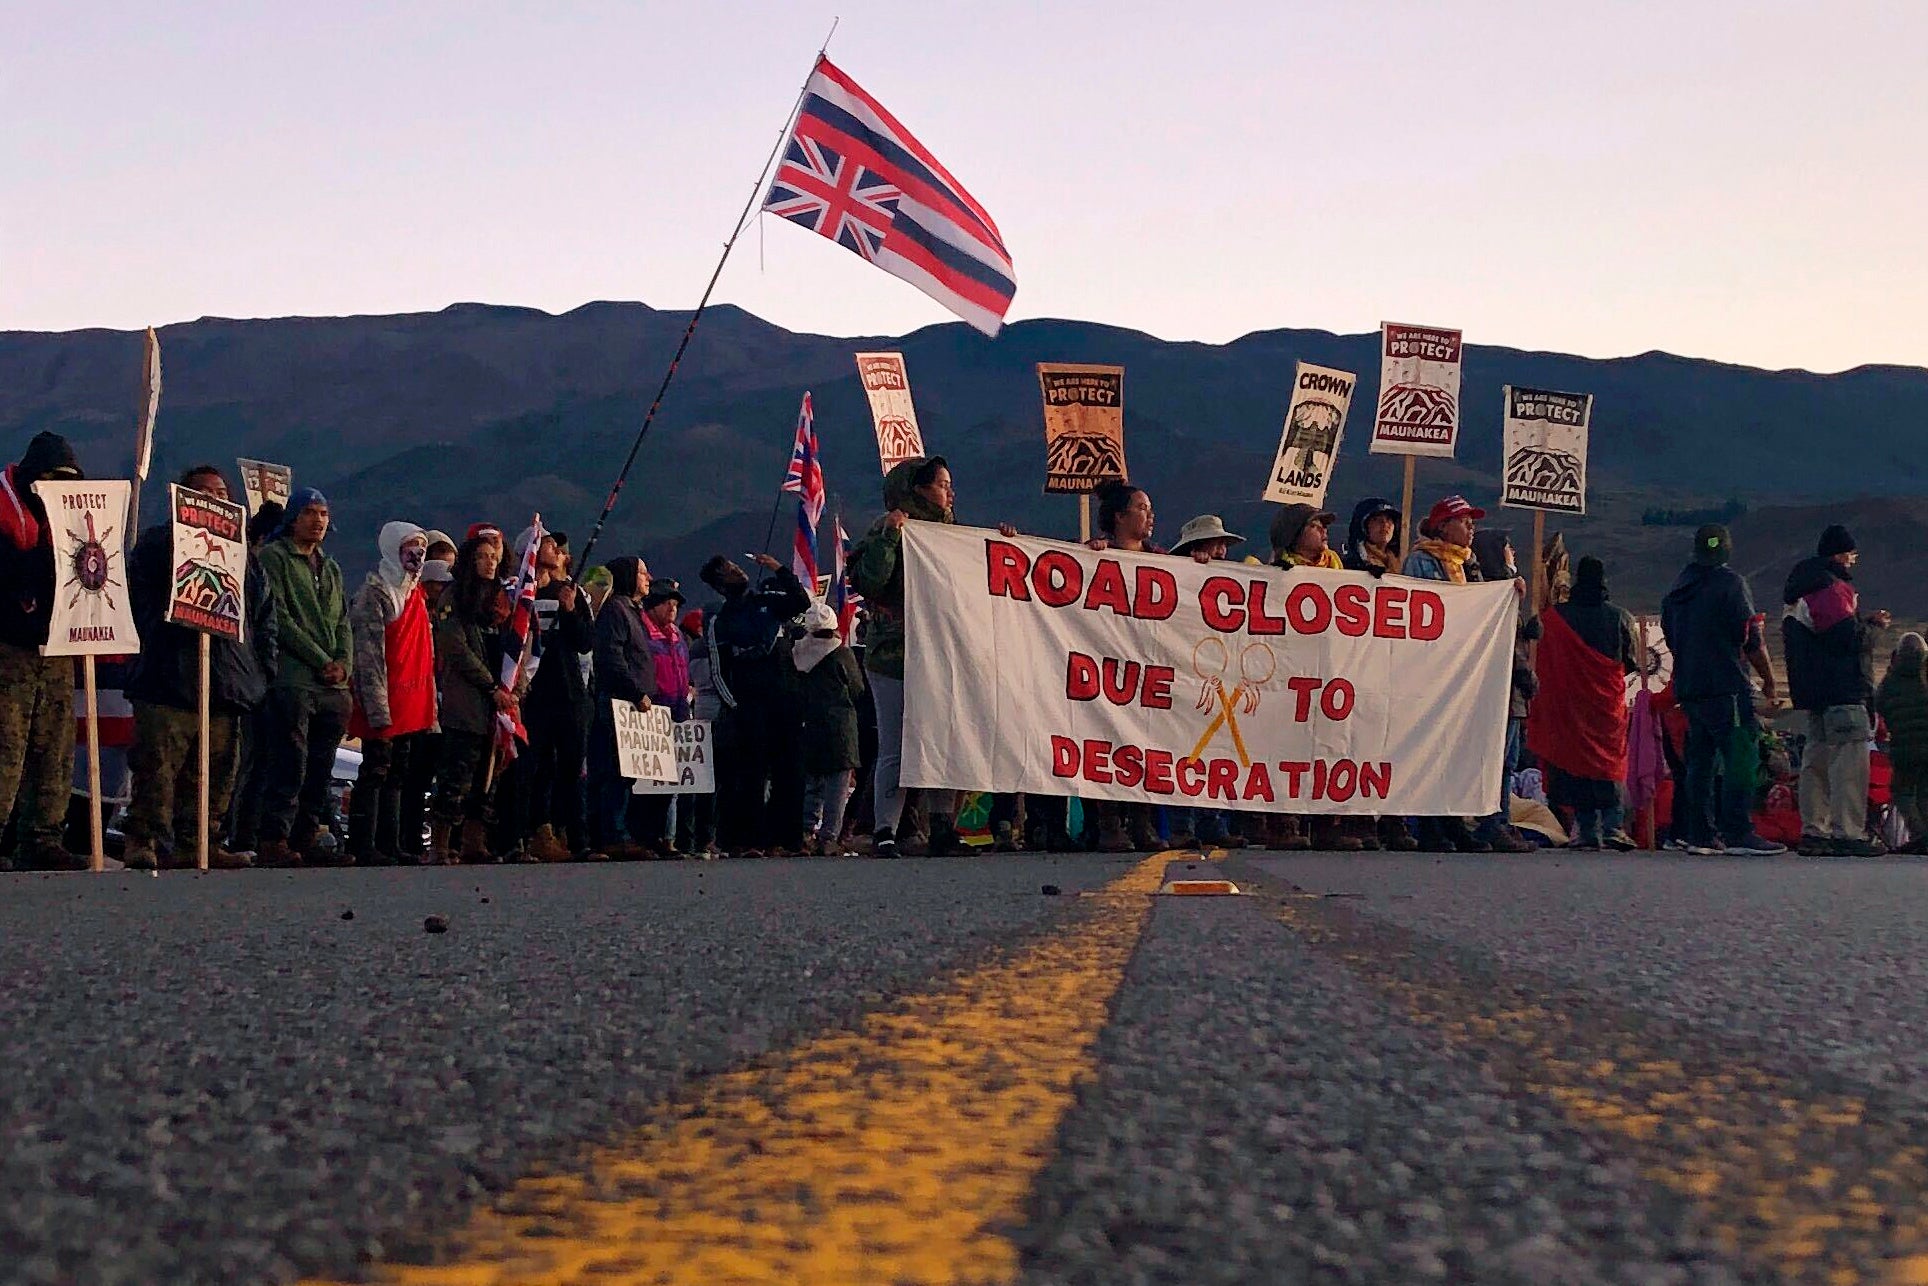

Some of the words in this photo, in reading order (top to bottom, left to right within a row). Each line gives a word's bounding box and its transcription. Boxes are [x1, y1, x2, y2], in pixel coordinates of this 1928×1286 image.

[1396, 332, 1407, 340] WE
[1422, 334, 1439, 343] HERE
[1441, 337, 1450, 345] TO
[1391, 340, 1454, 359] PROTECT
[1300, 372, 1352, 398] CROWN
[1049, 387, 1115, 404] PROTECT
[1516, 402, 1580, 422] PROTECT
[1380, 424, 1449, 440] MAUNAKEA
[1048, 476, 1102, 489] MAUNA
[1276, 466, 1322, 489] LANDS
[61, 493, 107, 509] PROTECT
[1508, 488, 1578, 506] MAUNAKEA
[985, 538, 1179, 620] ROAD
[1198, 575, 1446, 641] CLOSED
[68, 626, 115, 642] MAUNAKEA
[1065, 650, 1175, 710] DUE
[1287, 676, 1355, 723] TO
[618, 704, 671, 737] SACRED
[620, 730, 671, 755] MAUNA
[673, 724, 705, 744] RED
[631, 753, 663, 776] KEA
[1050, 734, 1392, 802] DESECRATION
